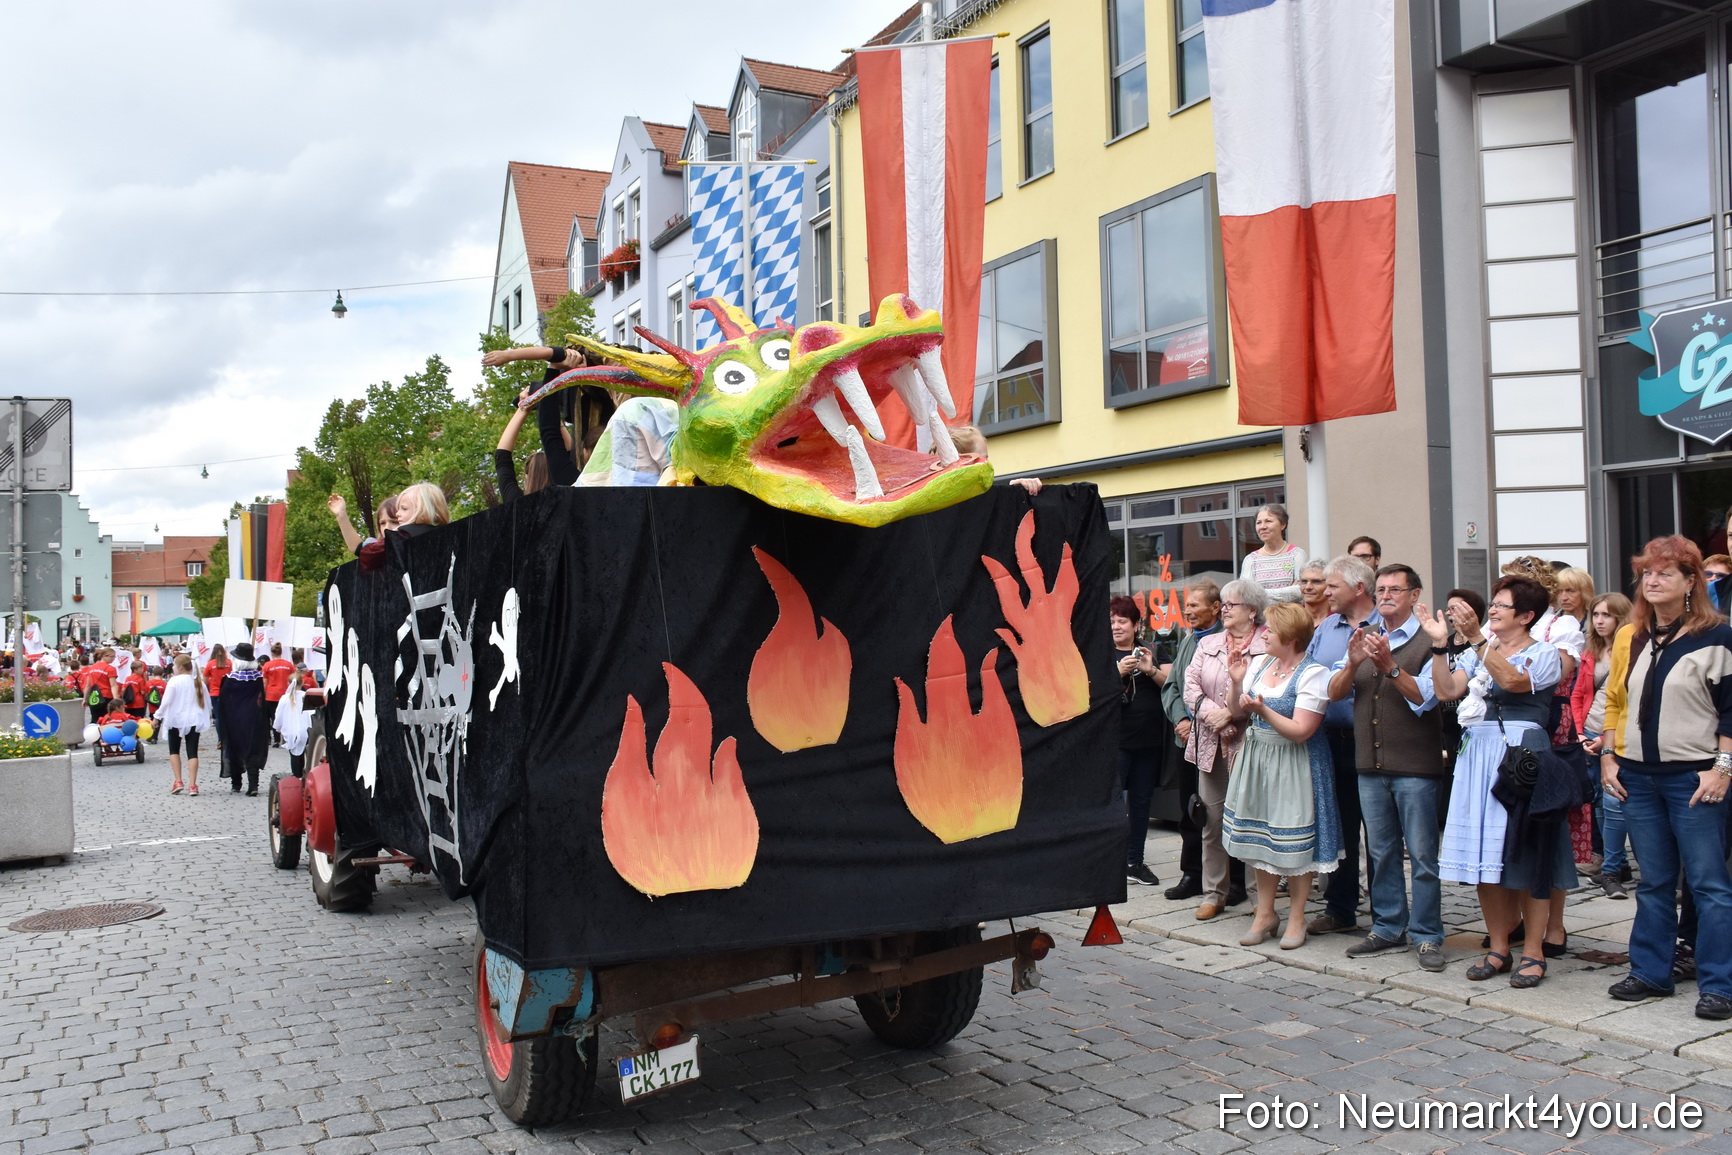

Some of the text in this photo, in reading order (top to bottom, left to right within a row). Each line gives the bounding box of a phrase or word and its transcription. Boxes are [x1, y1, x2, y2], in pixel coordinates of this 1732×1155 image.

[1158, 553, 1173, 583] %
[633, 1050, 660, 1074] NM
[630, 1059, 694, 1096] CK 177
